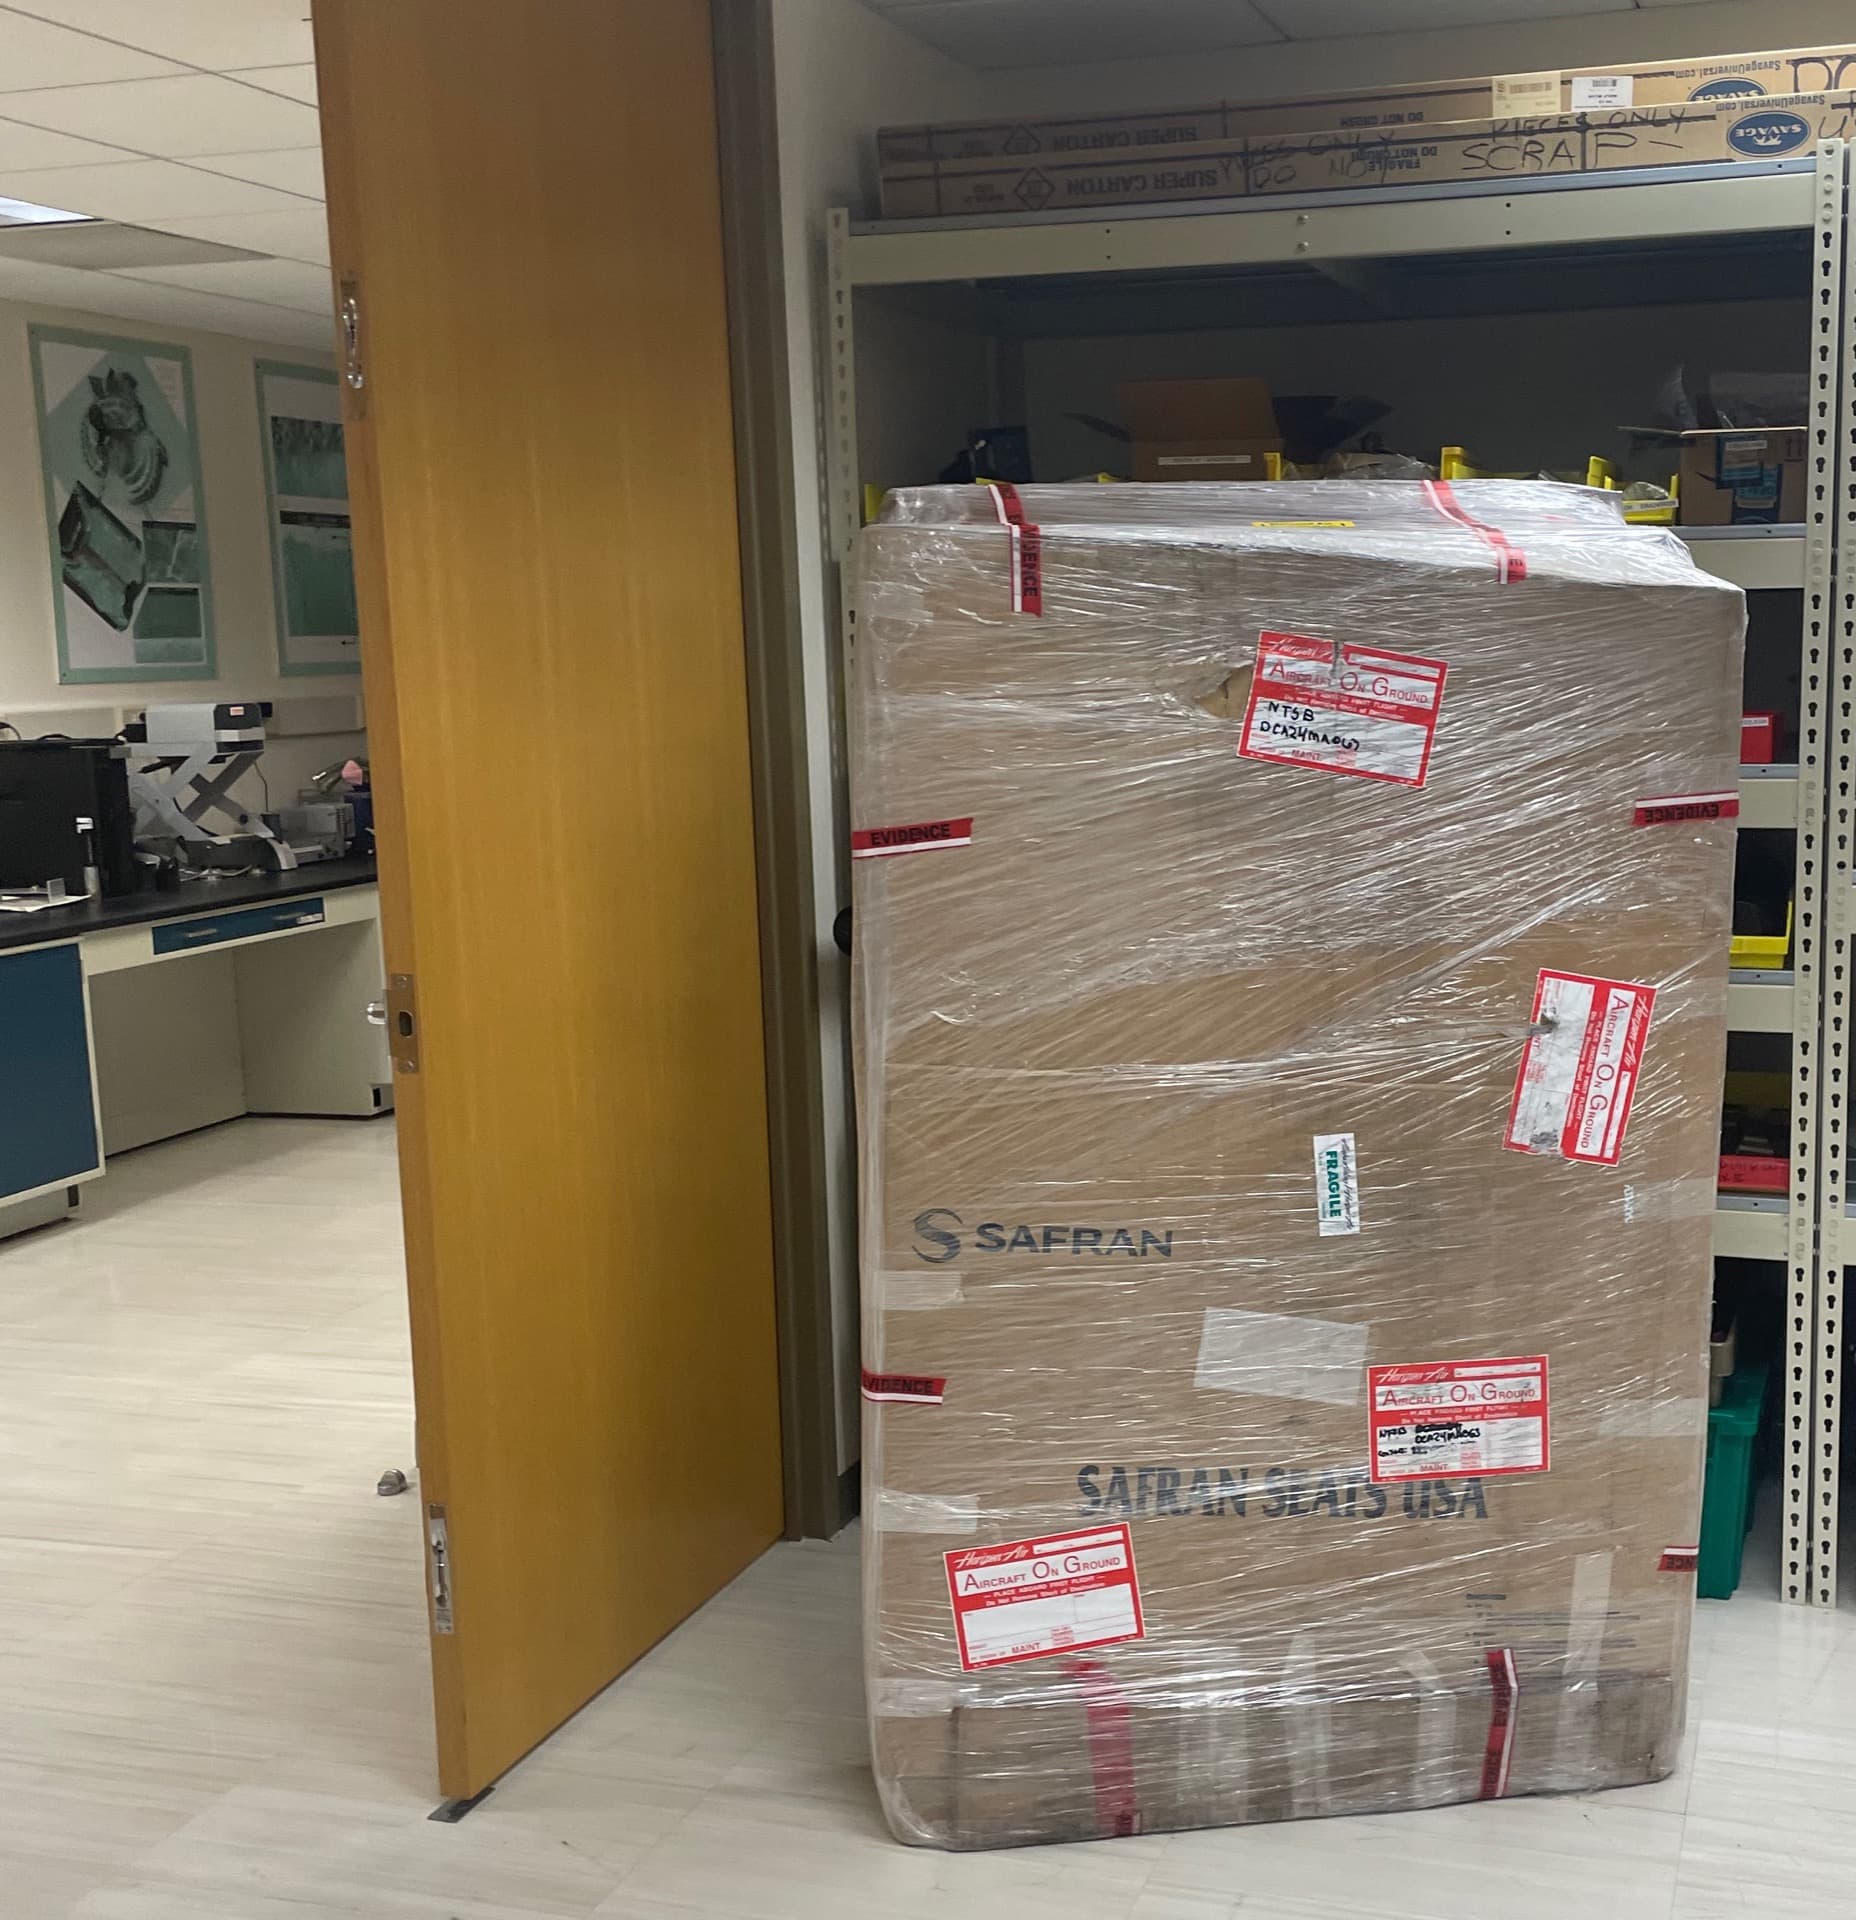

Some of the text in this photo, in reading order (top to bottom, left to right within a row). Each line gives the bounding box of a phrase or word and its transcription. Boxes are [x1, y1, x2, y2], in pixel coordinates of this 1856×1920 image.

[1674, 59, 1781, 78] SavageUniversal.com
[1716, 95, 1825, 112] SavageUniversal.com
[1609, 107, 1686, 132] ONLY
[1735, 123, 1801, 137] SAVAGE
[1052, 125, 1198, 151] SUPER CARTON
[1421, 145, 1437, 157] DO
[1066, 167, 1217, 196] SUPER CARTON
[1372, 677, 1428, 704] GROUND
[1268, 701, 1315, 722] NTSB
[1645, 803, 1720, 824] EVIDENCE
[870, 824, 951, 846] EVIDENCE
[1326, 1150, 1342, 1217] FRAGILE
[975, 1222, 1173, 1258] SAFRAN
[1077, 1464, 1488, 1519] SAFRAN SEATS USA
[954, 1544, 1030, 1569] Horizon Air
